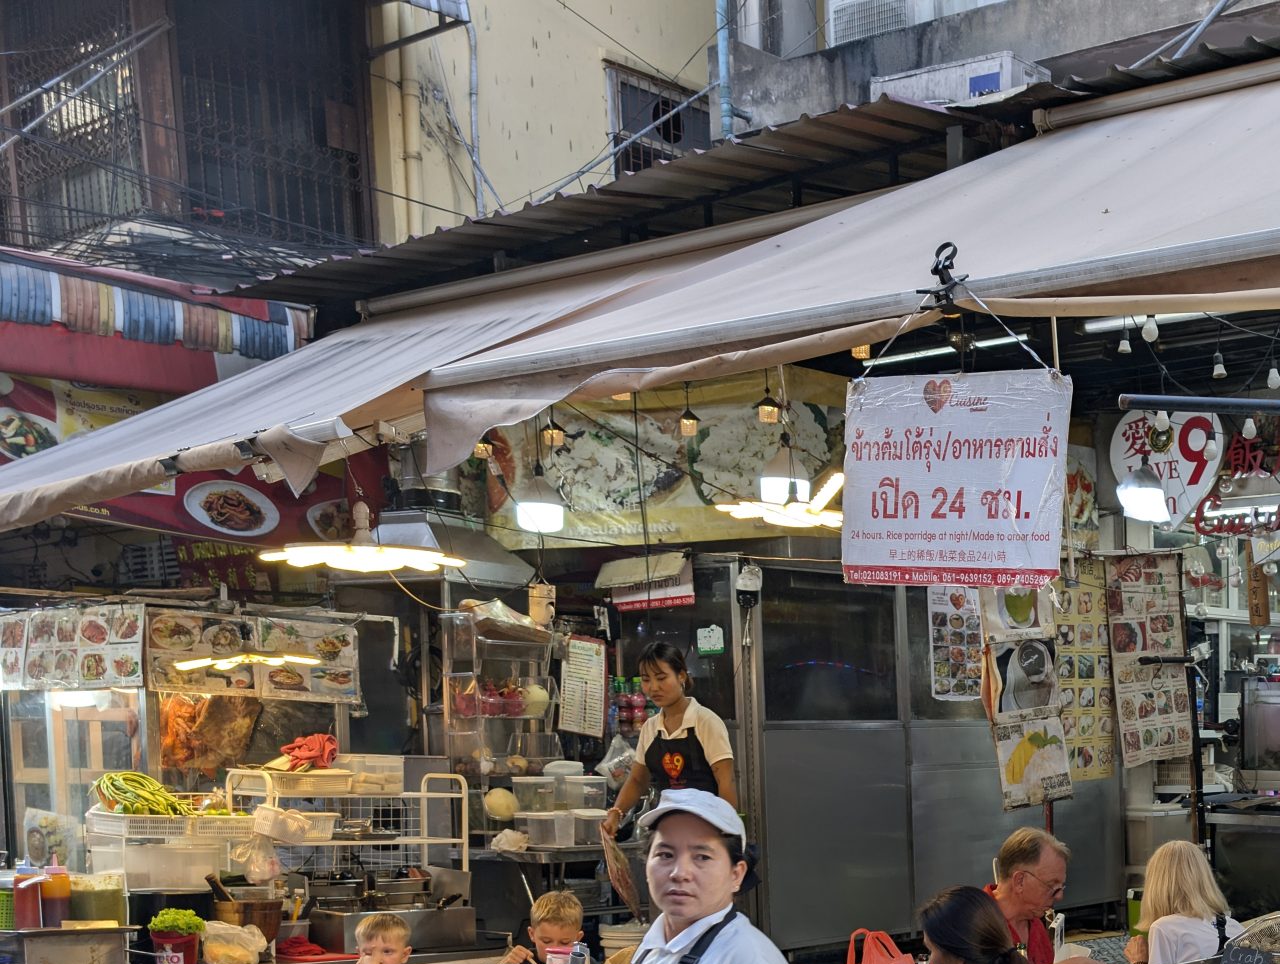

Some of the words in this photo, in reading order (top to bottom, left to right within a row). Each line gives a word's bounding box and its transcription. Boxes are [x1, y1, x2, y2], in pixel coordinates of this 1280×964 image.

[1178, 415, 1214, 486] 9
[871, 477, 920, 519] เปิด
[930, 486, 966, 520] 24
[851, 530, 861, 541] 24
[862, 530, 884, 541] hours.
[886, 529, 903, 541] Rice
[904, 530, 937, 543] porridge
[938, 531, 948, 541] at
[996, 531, 1005, 542] to
[1031, 530, 1051, 542] food
[911, 572, 940, 582] Mobile:
